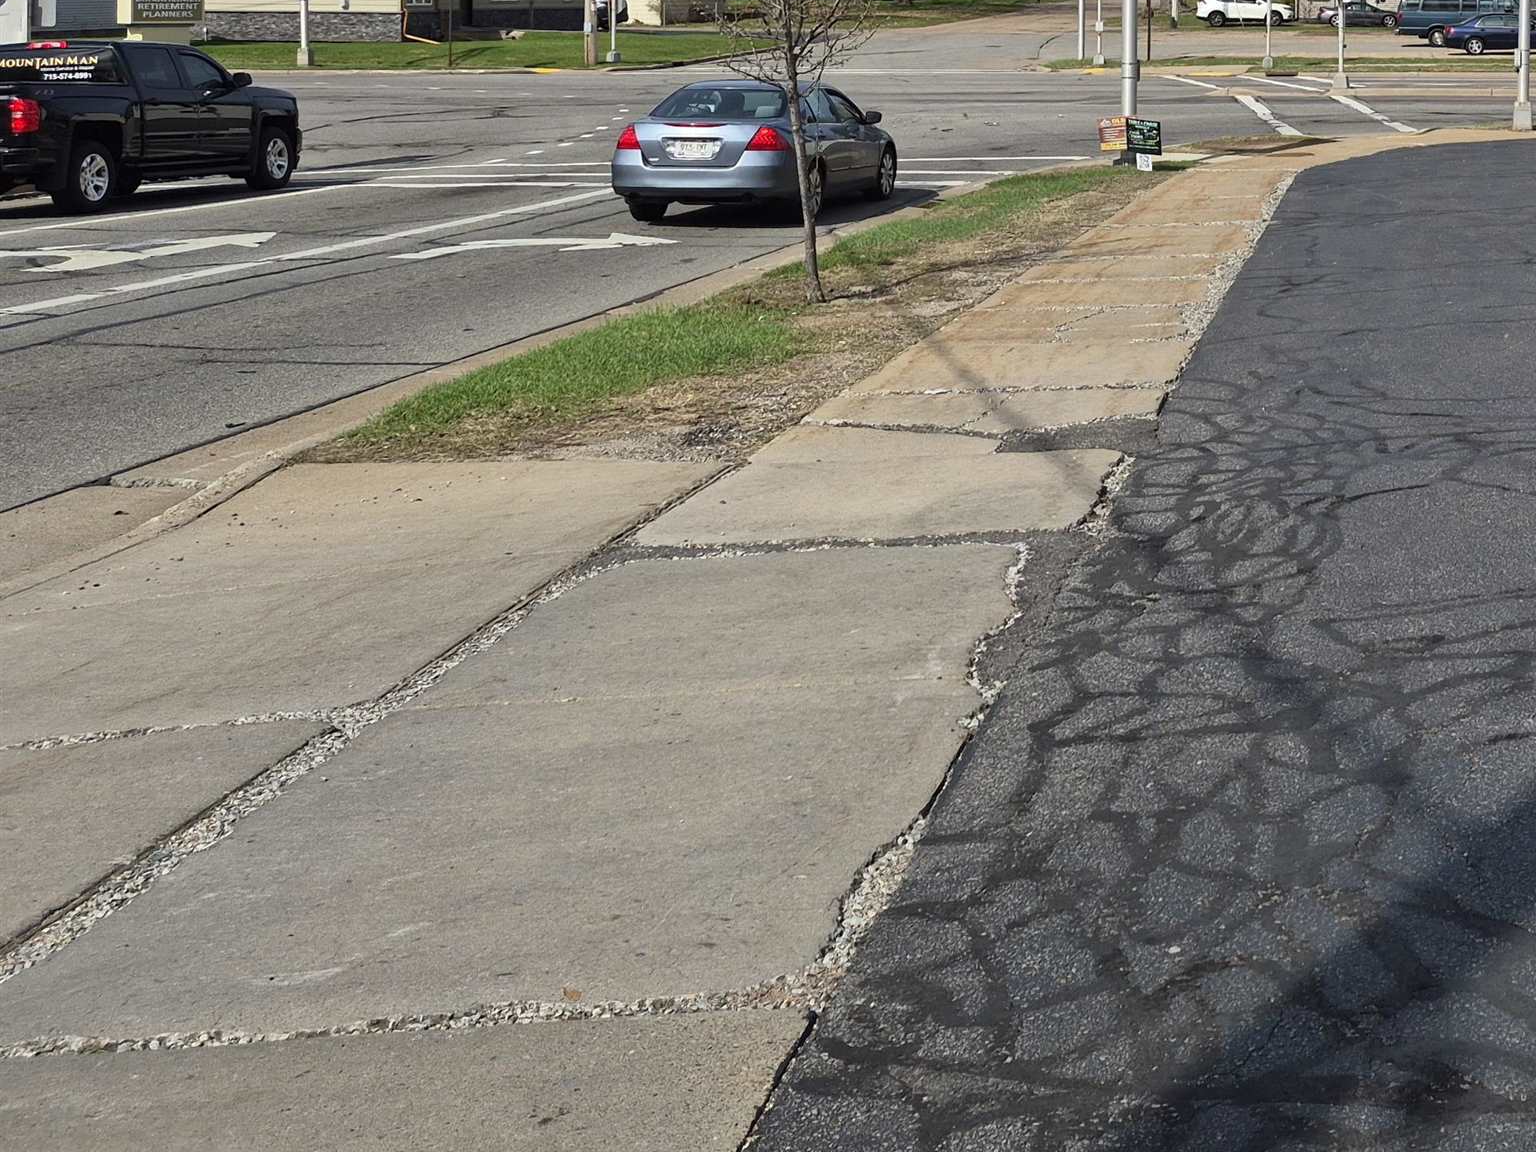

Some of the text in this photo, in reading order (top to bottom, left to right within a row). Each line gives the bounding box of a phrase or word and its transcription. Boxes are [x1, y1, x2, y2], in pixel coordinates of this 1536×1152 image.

[137, 2, 198, 10] RETIREMENT
[143, 10, 194, 18] PLANNERS
[66, 55, 99, 66] MAN
